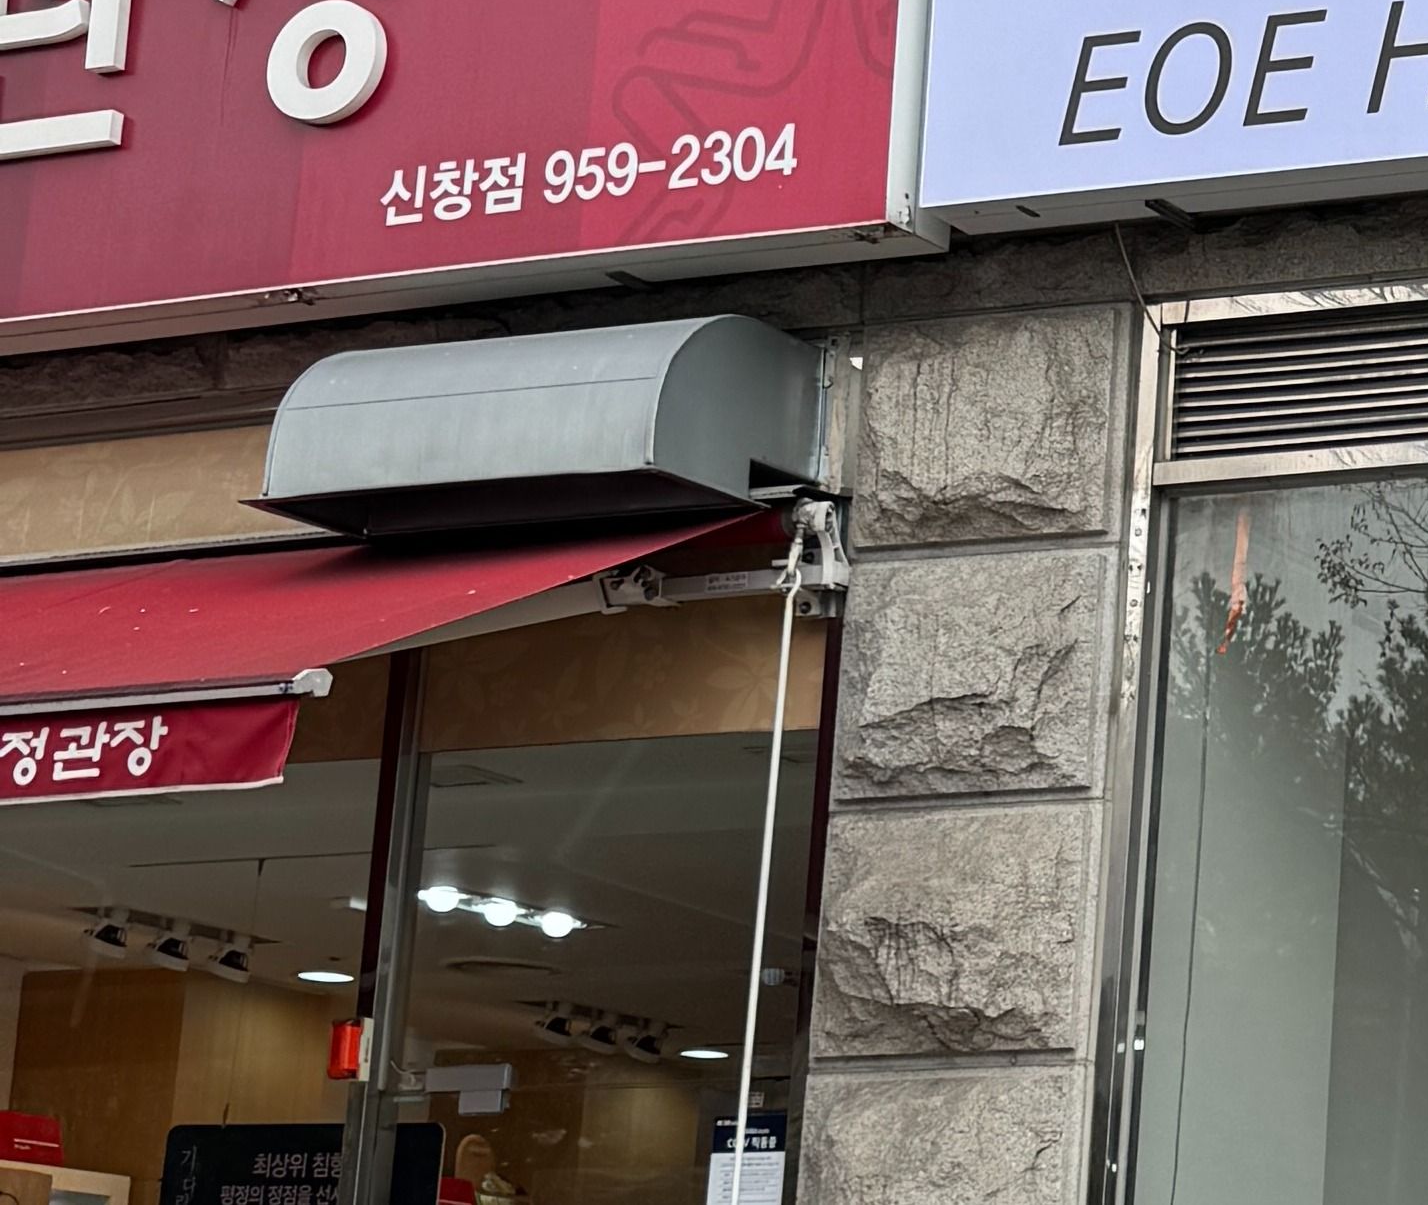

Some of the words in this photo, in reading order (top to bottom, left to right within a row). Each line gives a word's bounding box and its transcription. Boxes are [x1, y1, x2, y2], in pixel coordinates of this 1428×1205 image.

[1058, 8, 1327, 147] EOE
[380, 152, 527, 227] 신창점
[543, 122, 798, 204] 959-2304
[0, 715, 169, 786] 정관장
